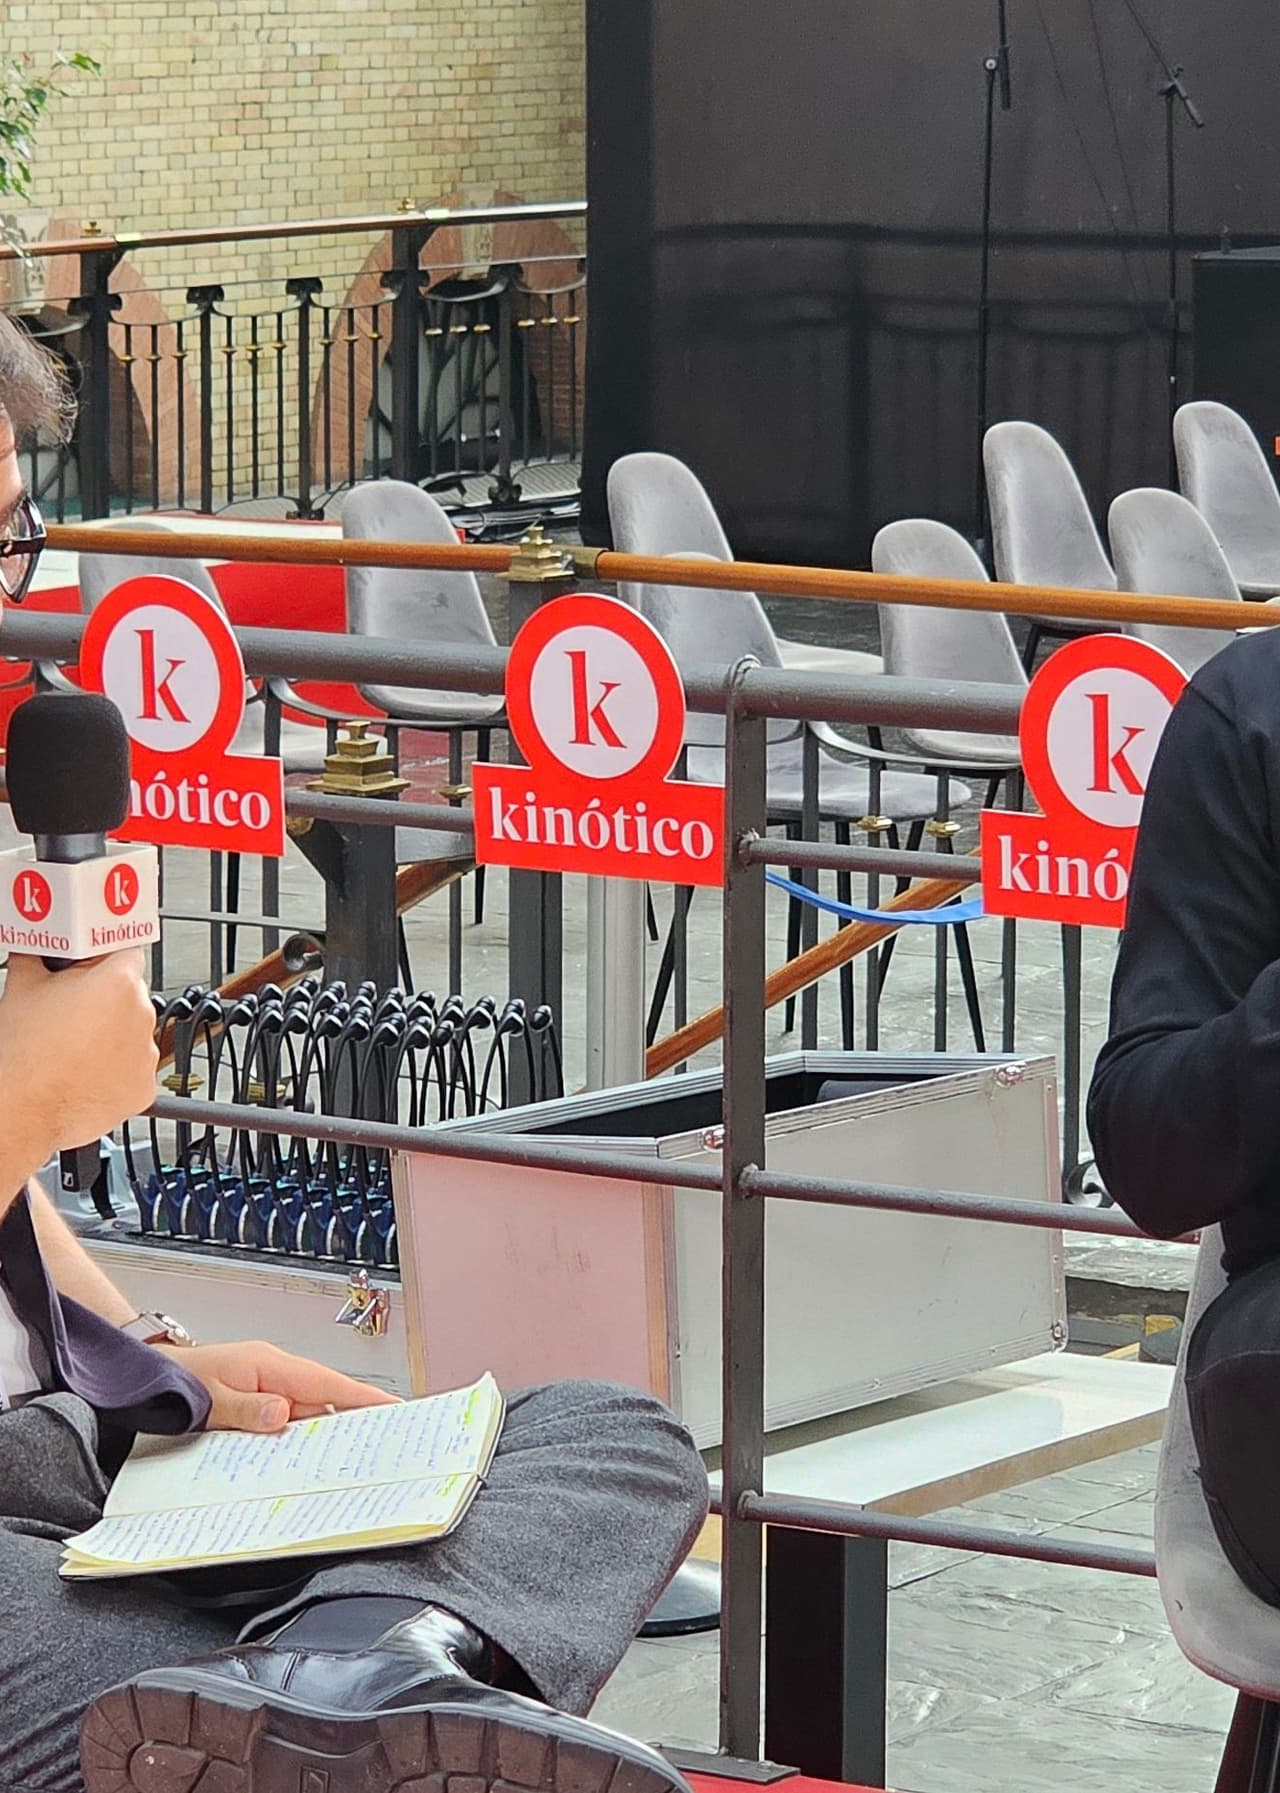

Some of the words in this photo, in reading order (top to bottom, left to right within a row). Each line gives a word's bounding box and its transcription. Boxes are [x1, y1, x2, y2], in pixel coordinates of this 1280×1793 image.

[134, 628, 191, 723] k
[564, 650, 627, 749] k
[1084, 693, 1146, 796] k
[489, 786, 713, 861] kinótico
[998, 835, 1129, 902] kinó
[0, 923, 69, 951] kinótico
[91, 920, 153, 947] kinótico
